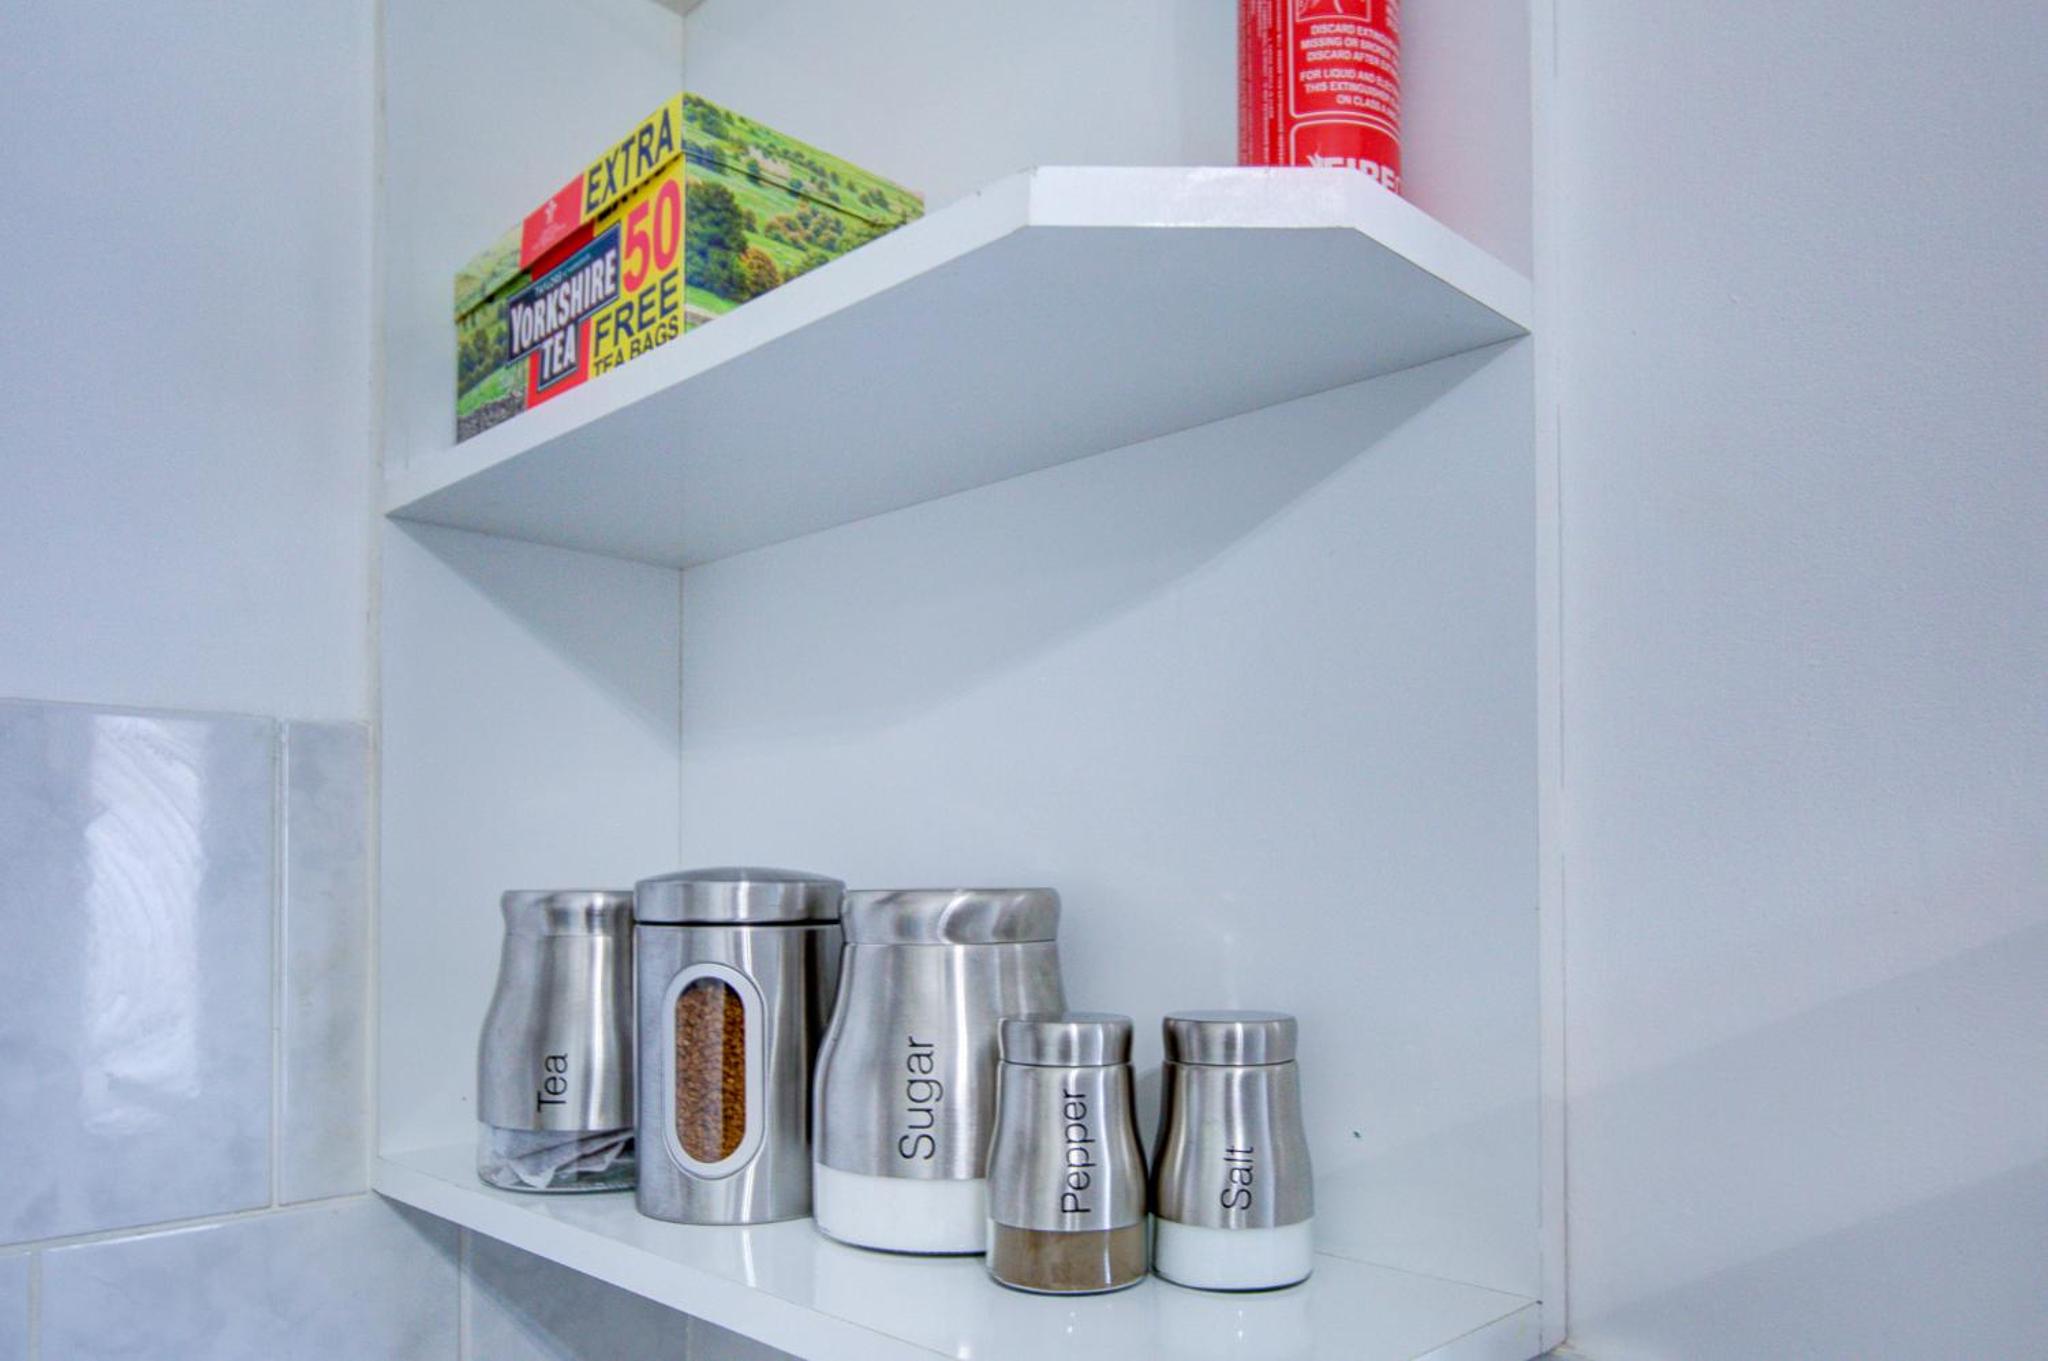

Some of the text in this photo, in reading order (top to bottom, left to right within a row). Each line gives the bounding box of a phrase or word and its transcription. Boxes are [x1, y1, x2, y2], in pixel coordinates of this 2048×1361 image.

[1300, 69, 1321, 81] FOR
[1344, 37, 1359, 47] OR
[584, 107, 674, 215] EXTRA
[622, 178, 681, 292] 50
[511, 248, 616, 354] YORKSHIRE
[595, 270, 678, 357] FREE
[630, 315, 679, 360] BAGS
[542, 325, 576, 380] TEA
[536, 1053, 568, 1112] Tea
[898, 1036, 943, 1160] Sugar
[1062, 1090, 1096, 1214] Pepper
[1221, 1145, 1254, 1212] Salt
